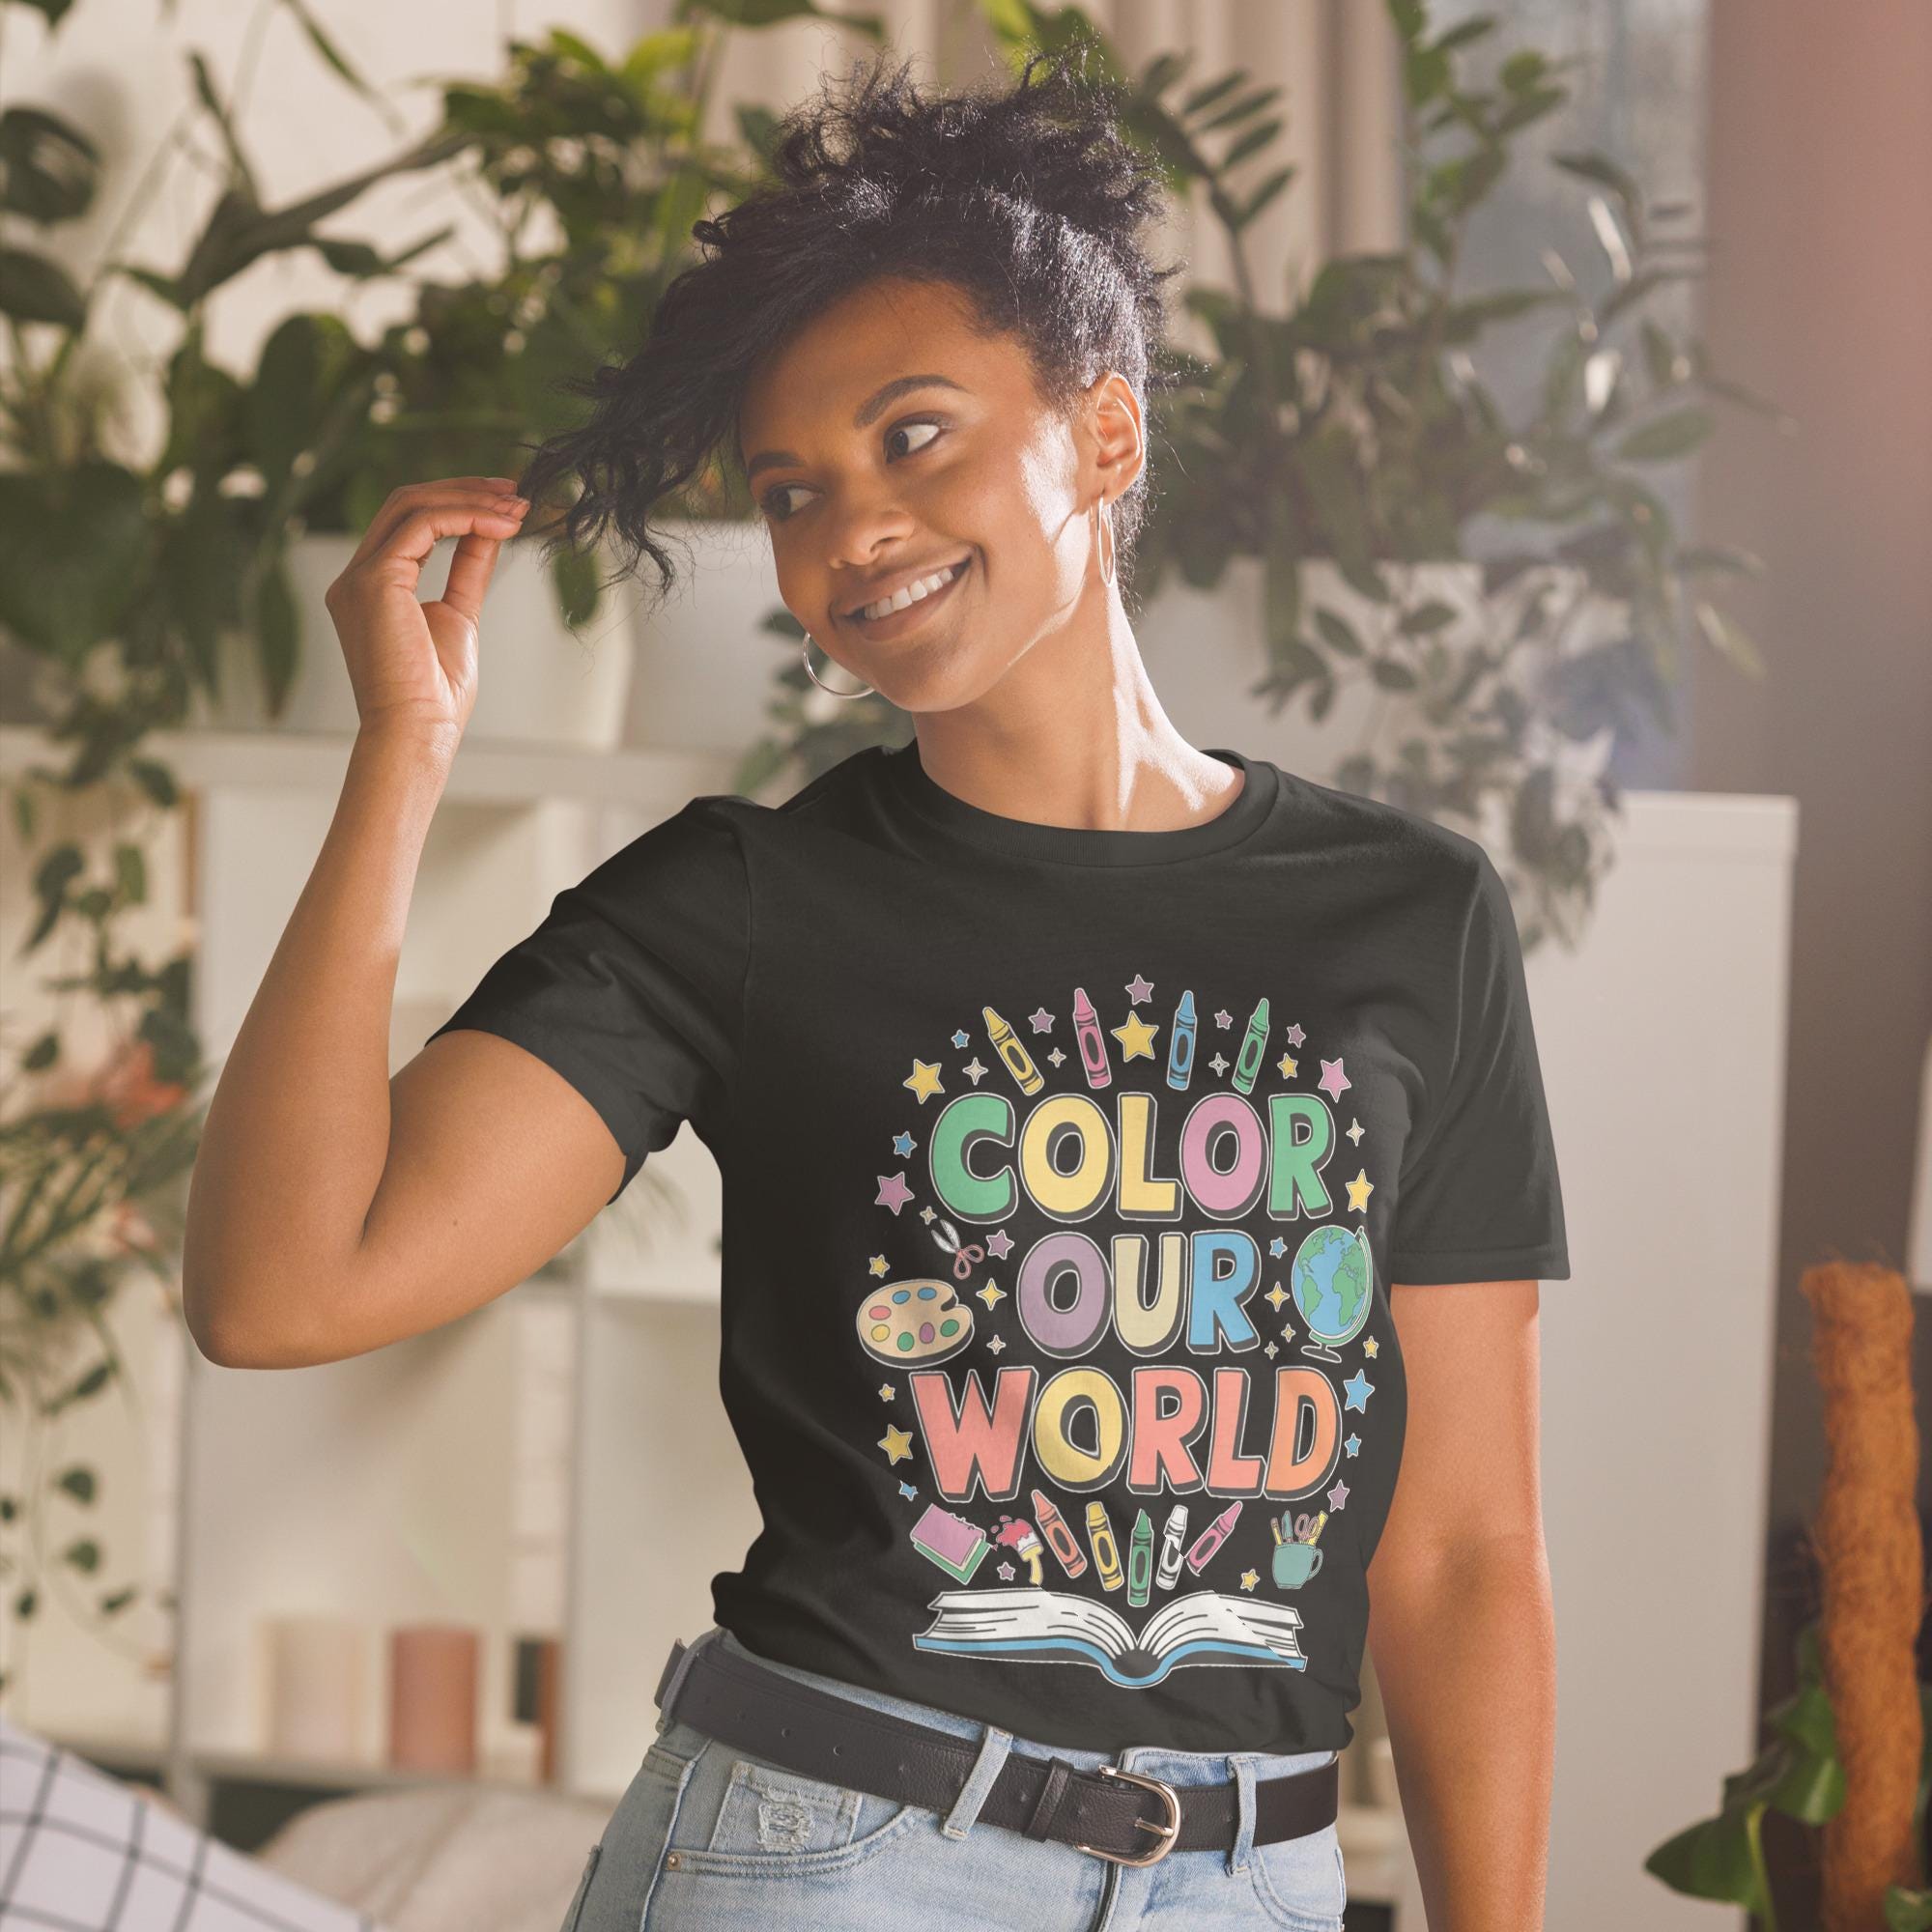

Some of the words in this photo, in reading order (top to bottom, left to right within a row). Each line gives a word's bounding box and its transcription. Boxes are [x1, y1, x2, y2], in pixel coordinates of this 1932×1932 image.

[929, 1092, 1336, 1224] COLOR
[1016, 1229, 1262, 1359] OUR
[908, 1365, 1343, 1503] WORLD
